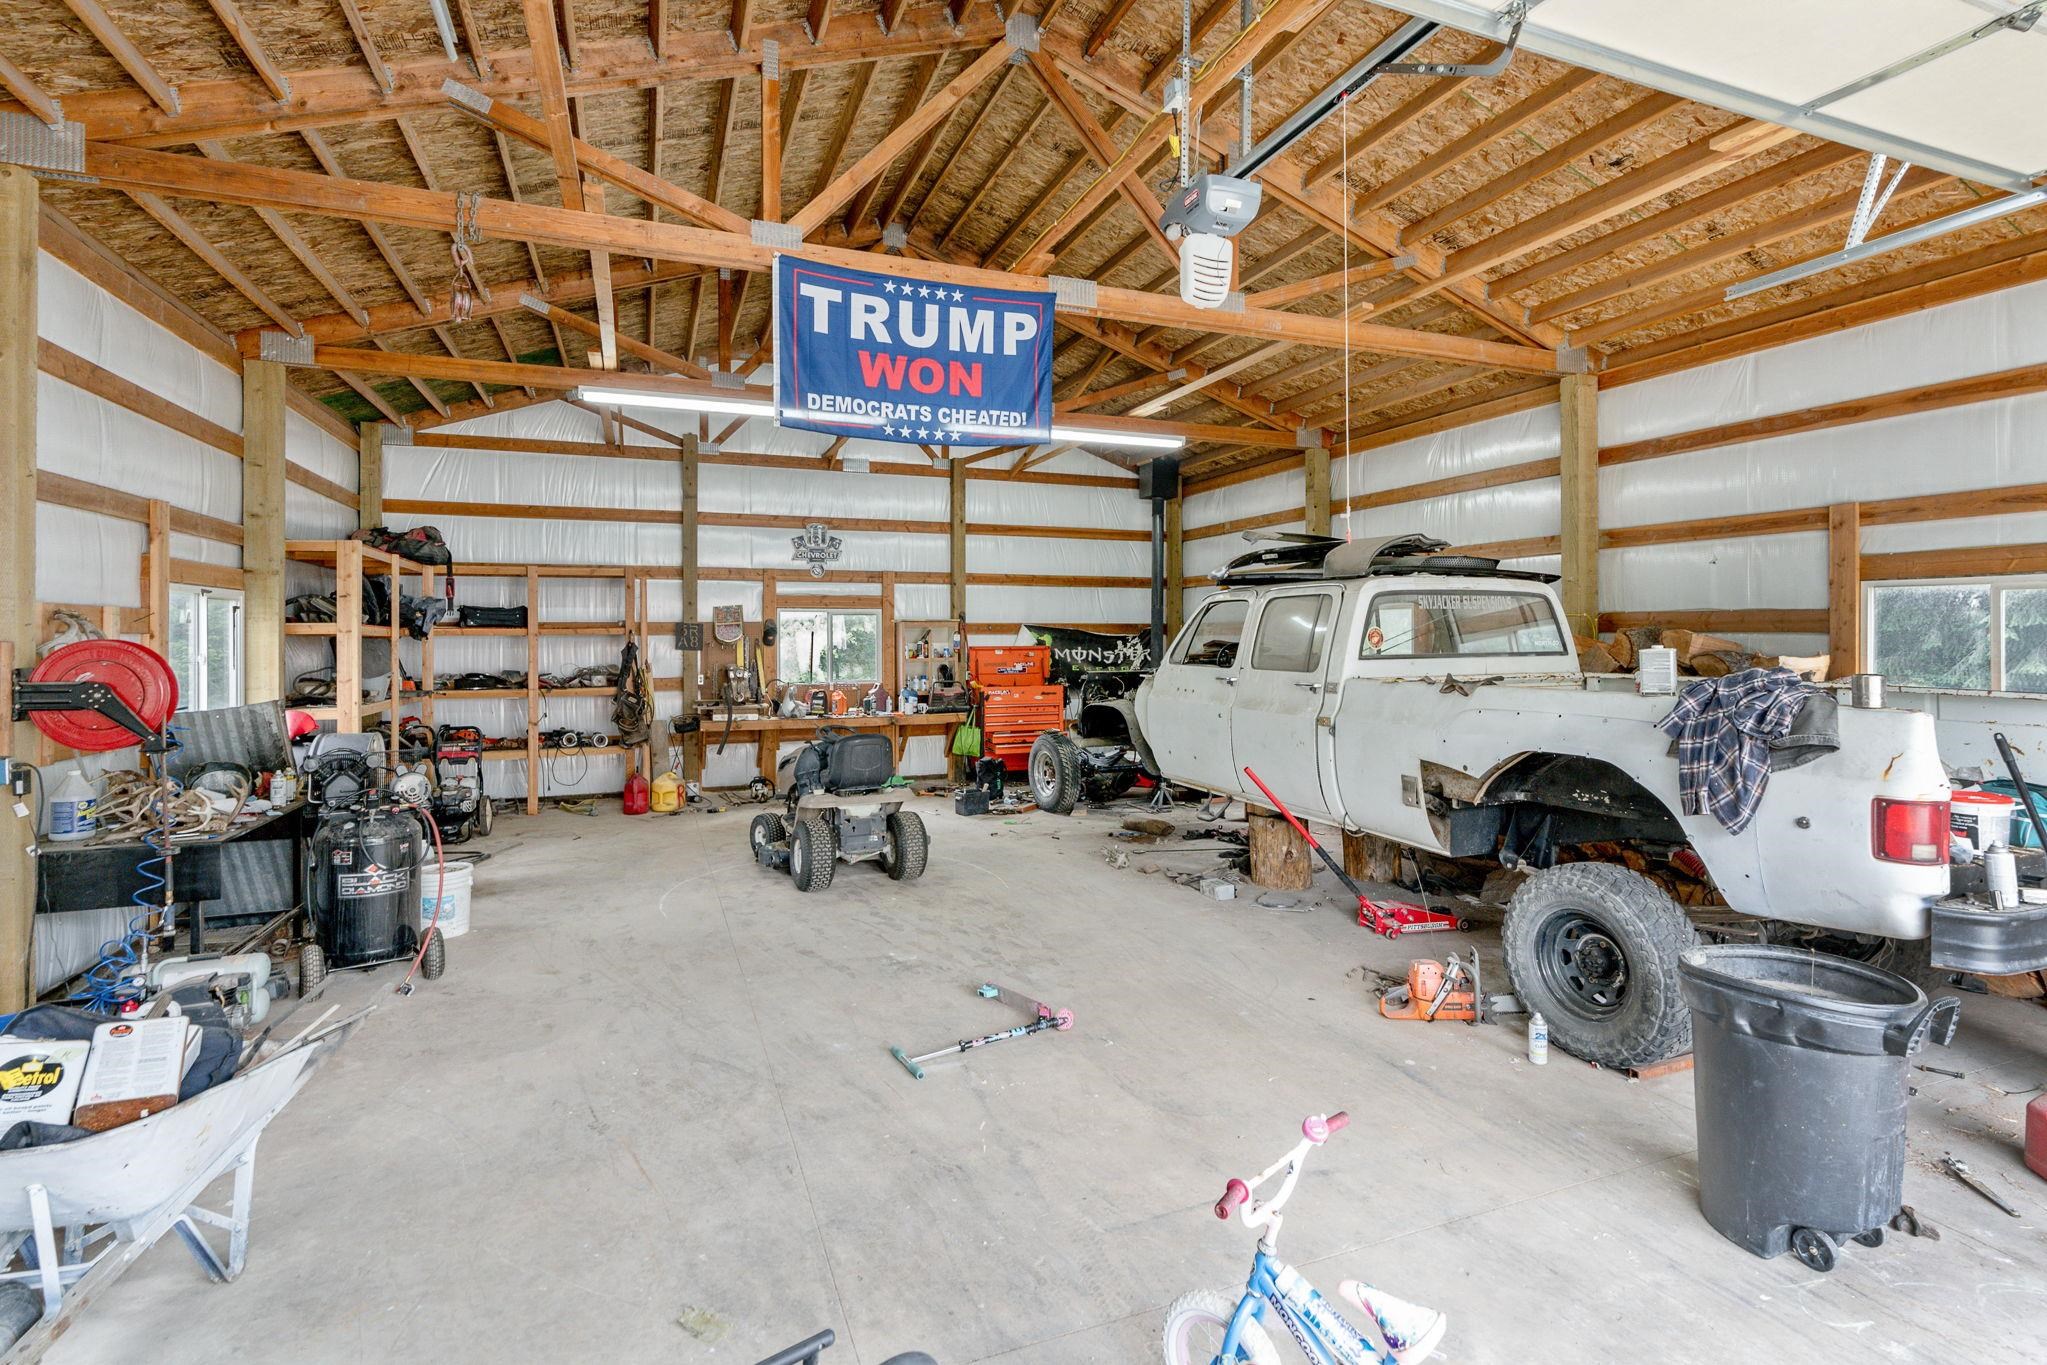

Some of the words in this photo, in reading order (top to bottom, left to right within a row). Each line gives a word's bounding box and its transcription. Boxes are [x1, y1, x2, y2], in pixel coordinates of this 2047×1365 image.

[800, 283, 1038, 356] TRUMP
[858, 350, 982, 398] WON
[807, 392, 932, 422] DEMOCRATS
[937, 406, 1027, 427] CHEATED!
[796, 551, 838, 559] CHEVROLET
[1054, 642, 1152, 663] MONSTER
[341, 880, 408, 895] DIAMOND
